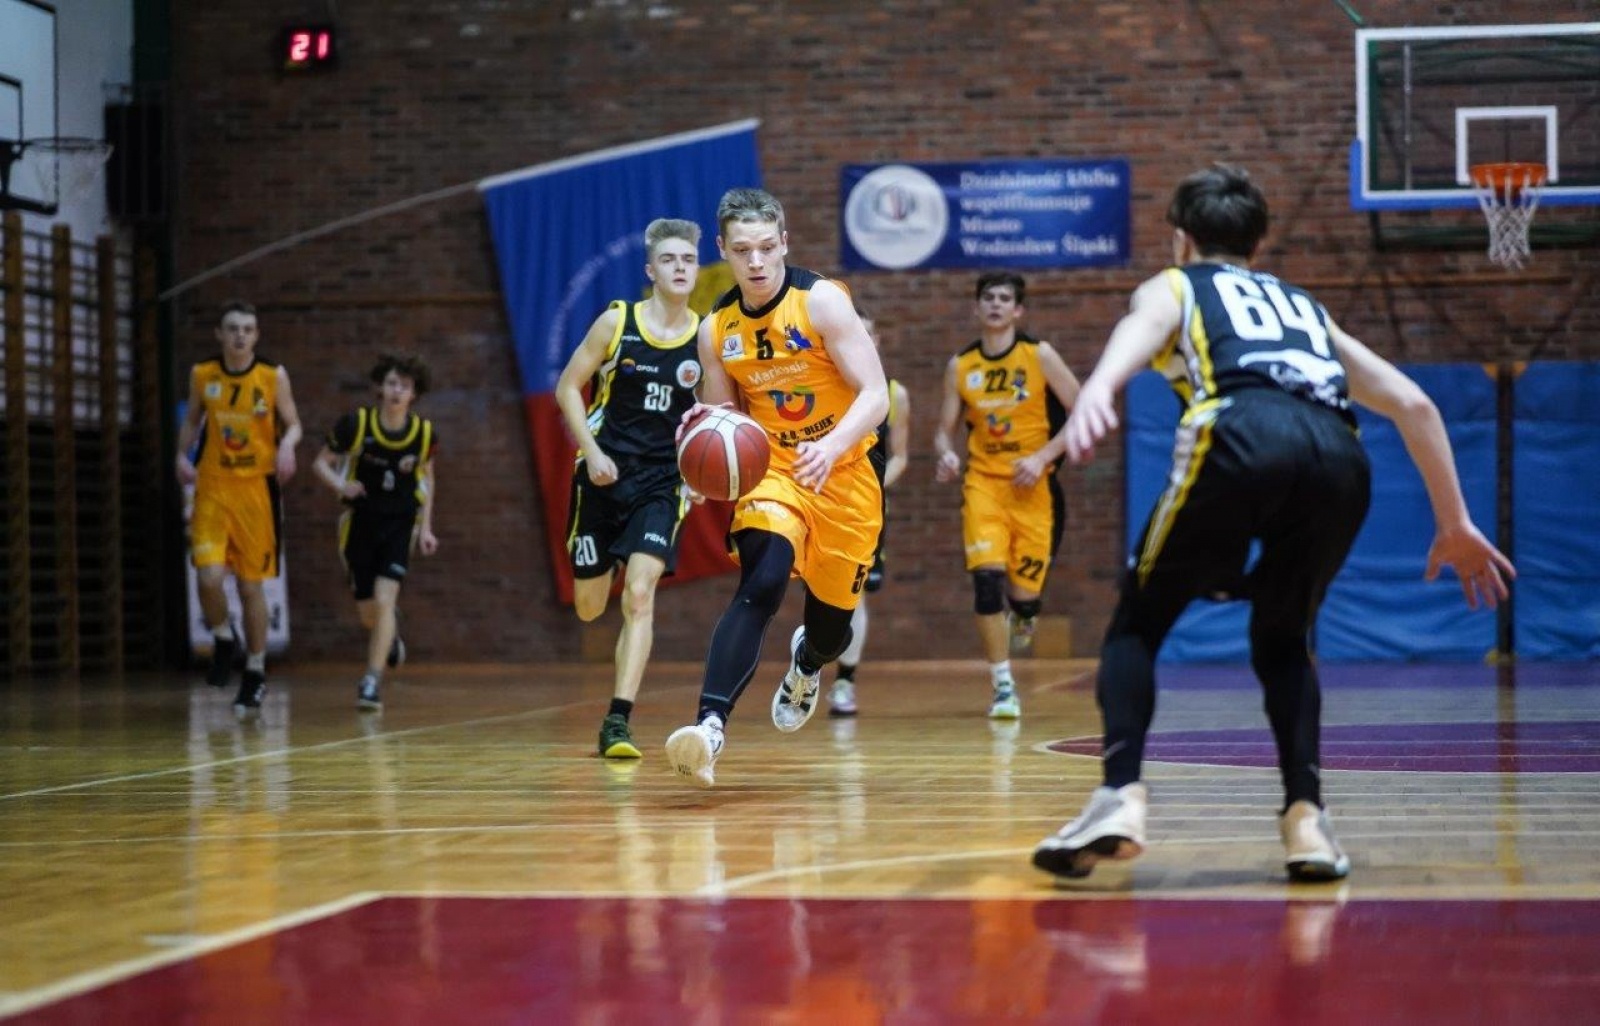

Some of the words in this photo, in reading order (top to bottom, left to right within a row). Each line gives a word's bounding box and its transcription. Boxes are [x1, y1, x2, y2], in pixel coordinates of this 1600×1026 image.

[291, 33, 328, 61] 21
[960, 216, 1022, 233] Miasto
[1212, 271, 1331, 360] 64
[755, 327, 774, 361] 5
[635, 364, 659, 373] OPOLE
[985, 368, 1007, 393] 22
[230, 384, 241, 406] 7
[644, 382, 673, 412] 20
[575, 535, 598, 566] 20
[851, 563, 867, 594] 5
[1016, 556, 1044, 581] 22
